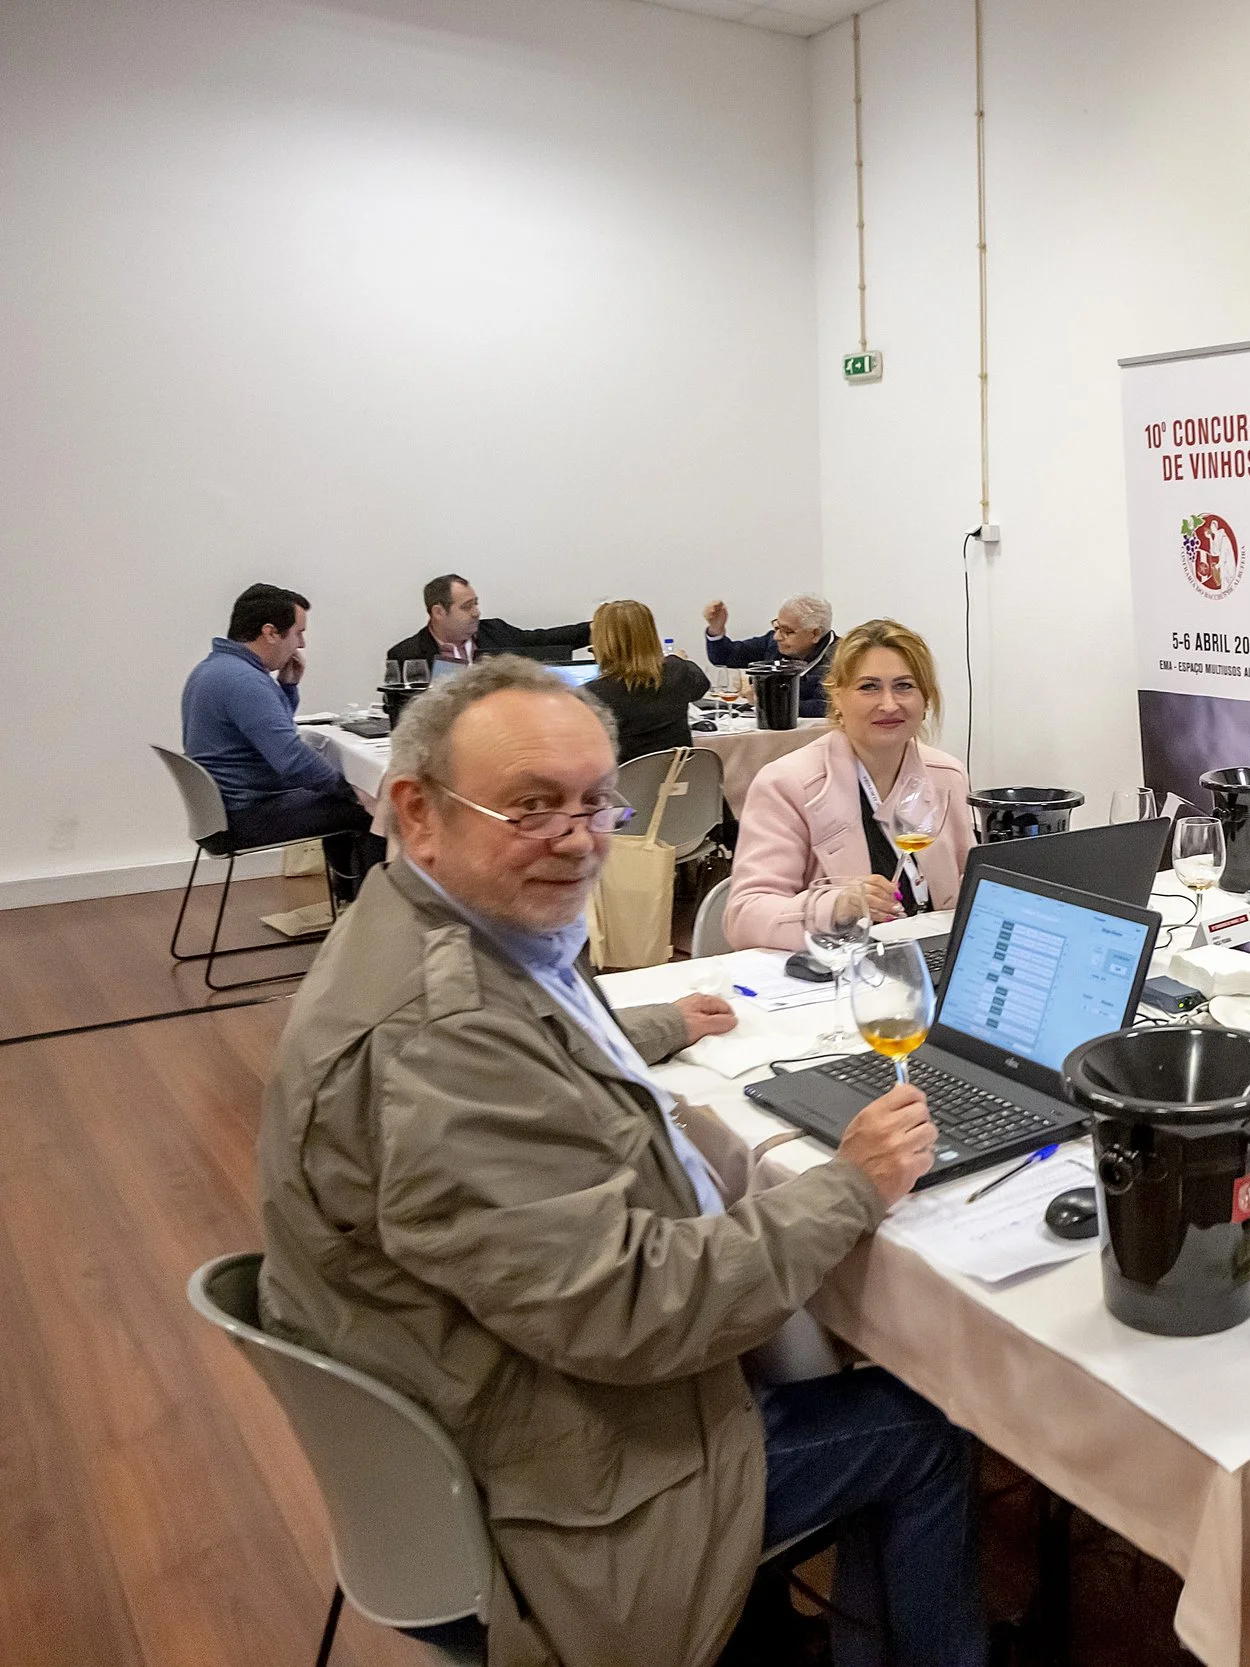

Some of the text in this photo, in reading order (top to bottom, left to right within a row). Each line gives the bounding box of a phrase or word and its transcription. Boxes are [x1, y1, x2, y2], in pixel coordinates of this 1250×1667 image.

[1144, 421, 1167, 449] 10º
[1162, 454, 1184, 481] DE
[1172, 632, 1191, 650] 5-6
[1195, 632, 1231, 653] ABRIL
[1159, 660, 1173, 670] EMA
[1178, 661, 1203, 675] ESPAÇO
[1205, 664, 1242, 677] MULTIUSOS
